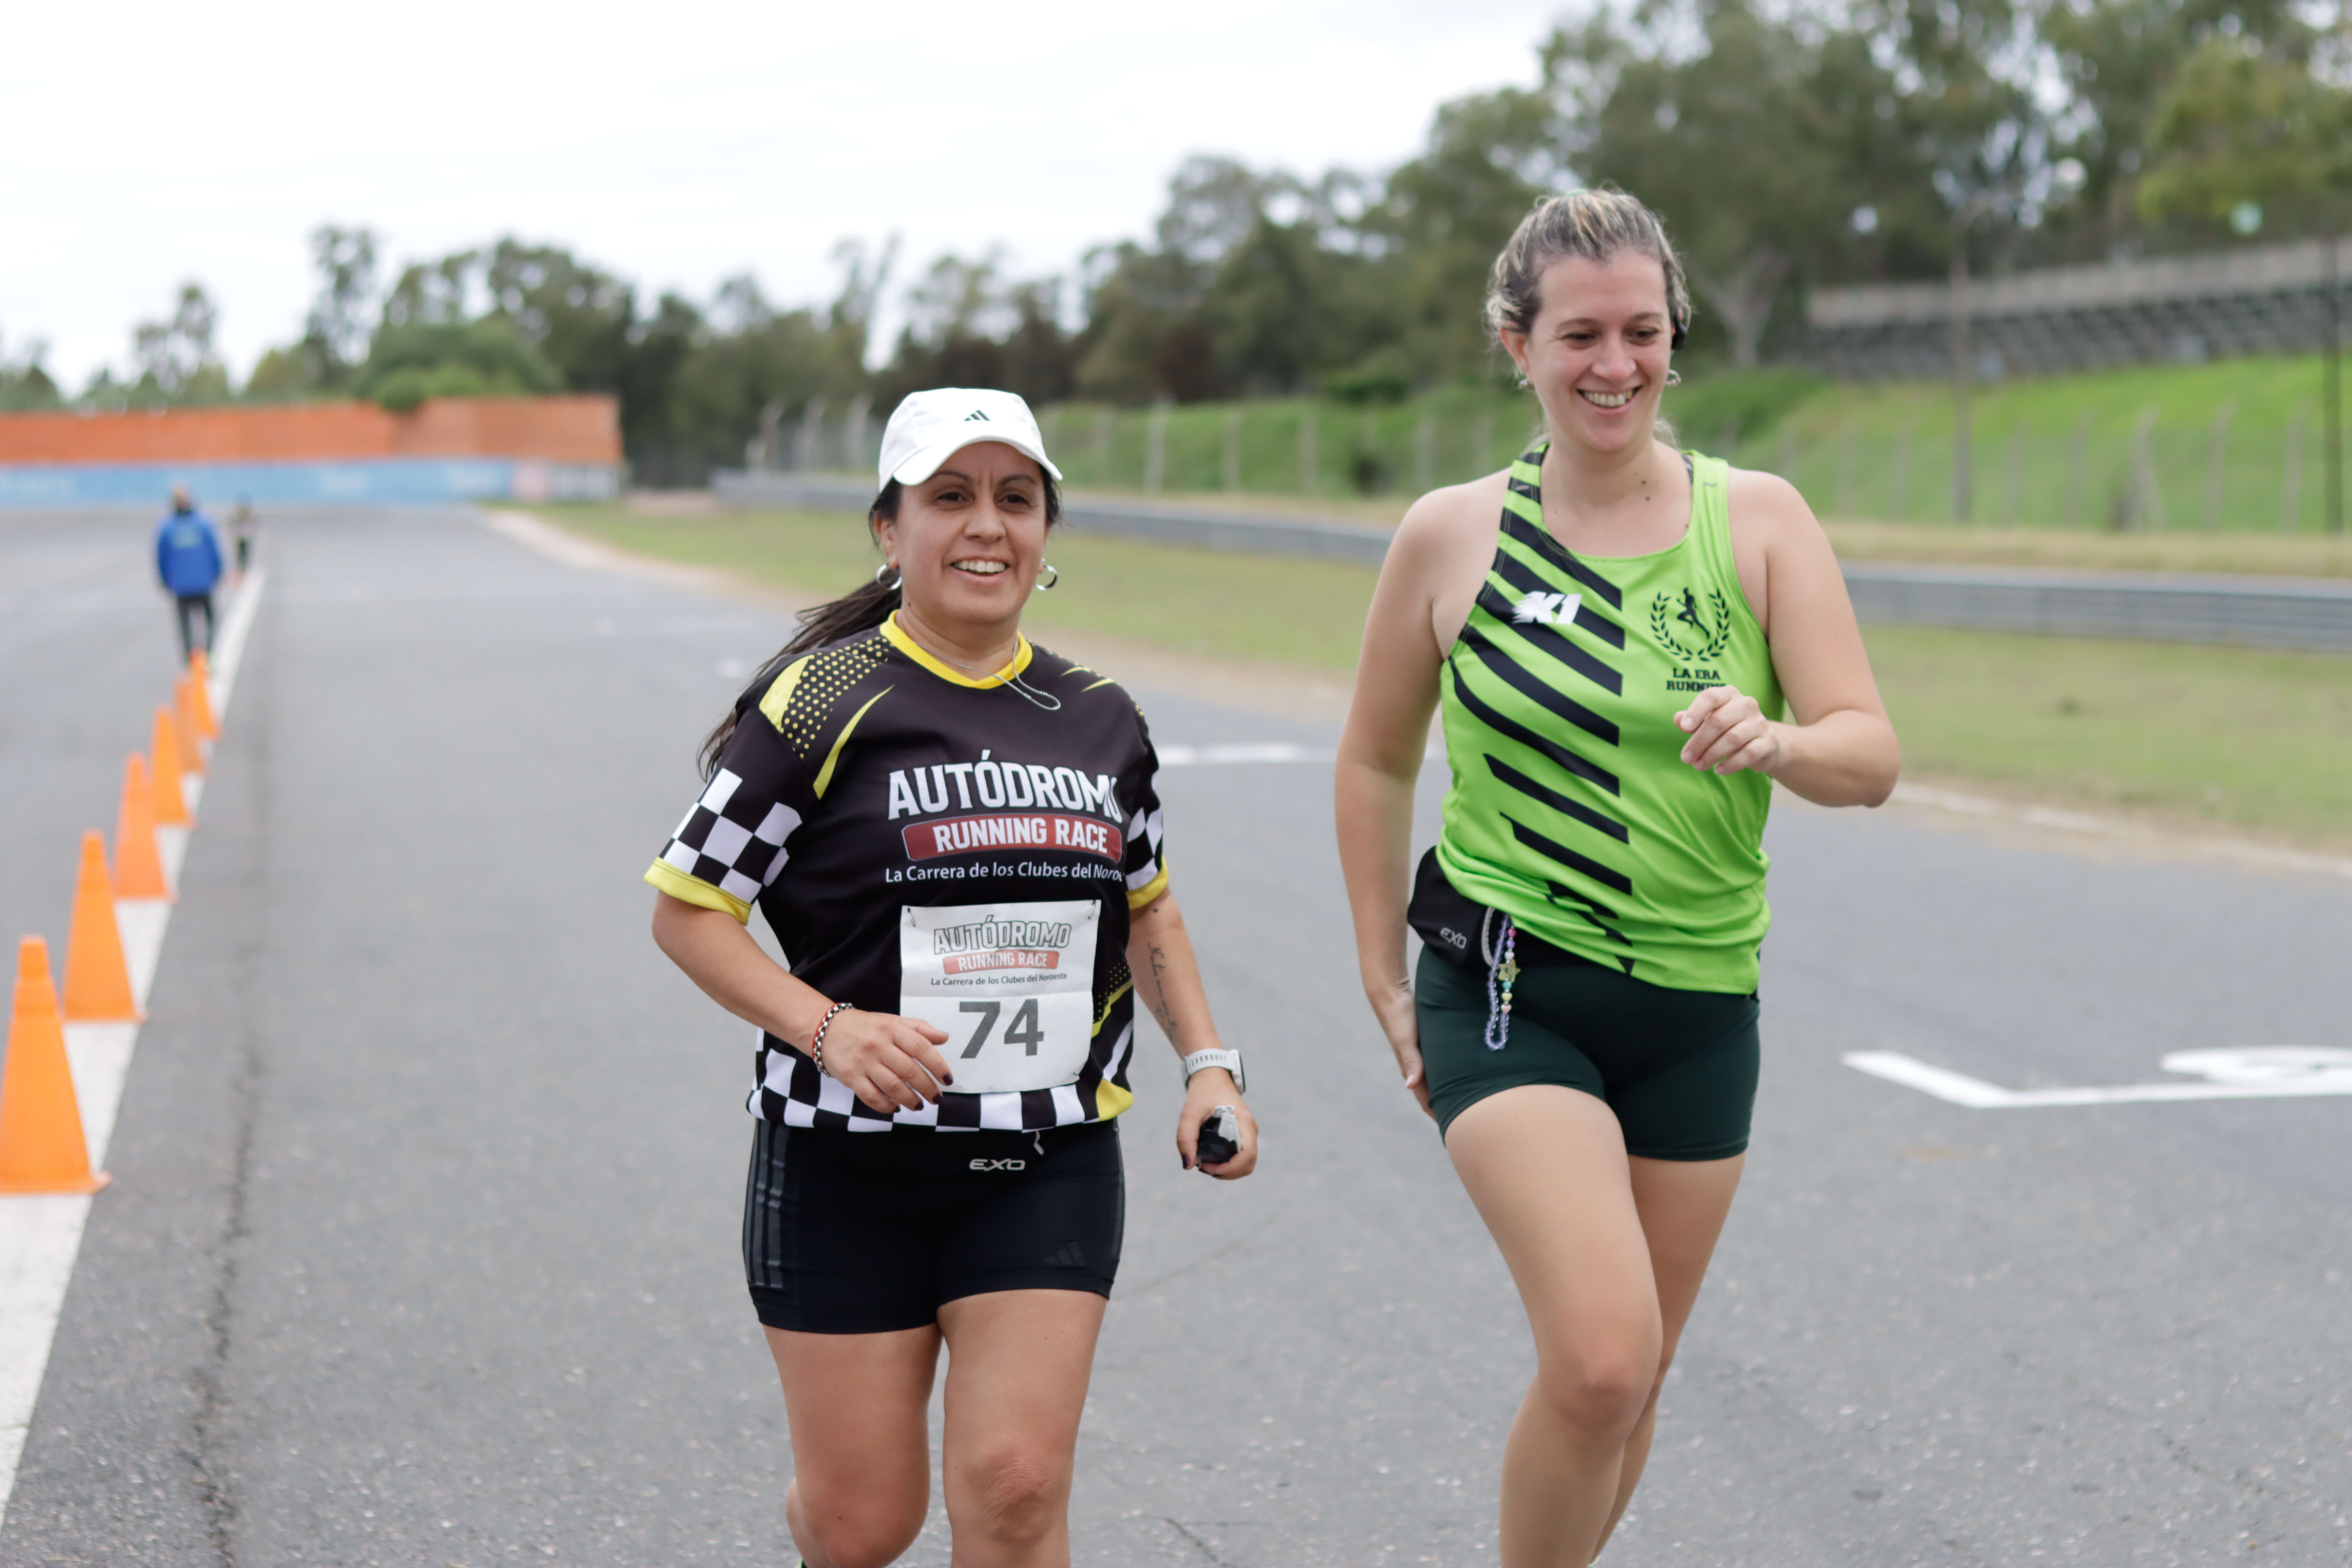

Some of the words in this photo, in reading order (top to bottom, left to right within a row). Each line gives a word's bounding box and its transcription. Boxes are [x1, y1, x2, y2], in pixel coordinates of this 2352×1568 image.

[1673, 667, 1691, 679] LA
[1694, 669, 1721, 680] ERA
[932, 818, 1047, 853] RUNNING
[1055, 818, 1107, 854] RACE
[885, 869, 902, 882] La
[906, 865, 965, 881] Carrera
[970, 862, 989, 878] de
[993, 862, 1014, 877] los
[1018, 861, 1068, 878] Clubes
[1071, 862, 1092, 878] del
[933, 914, 1072, 955] AUTÓDROMO
[1440, 928, 1467, 949] EXO
[958, 955, 1014, 971] RUNNING
[1019, 952, 1048, 968] RACE
[943, 977, 973, 985] Carrera
[976, 977, 986, 985] de
[988, 976, 999, 984] los
[1001, 975, 1025, 984] Clubes
[1039, 973, 1067, 981] Noroeste
[959, 998, 1044, 1059] 74
[969, 1158, 1025, 1171] EXO
